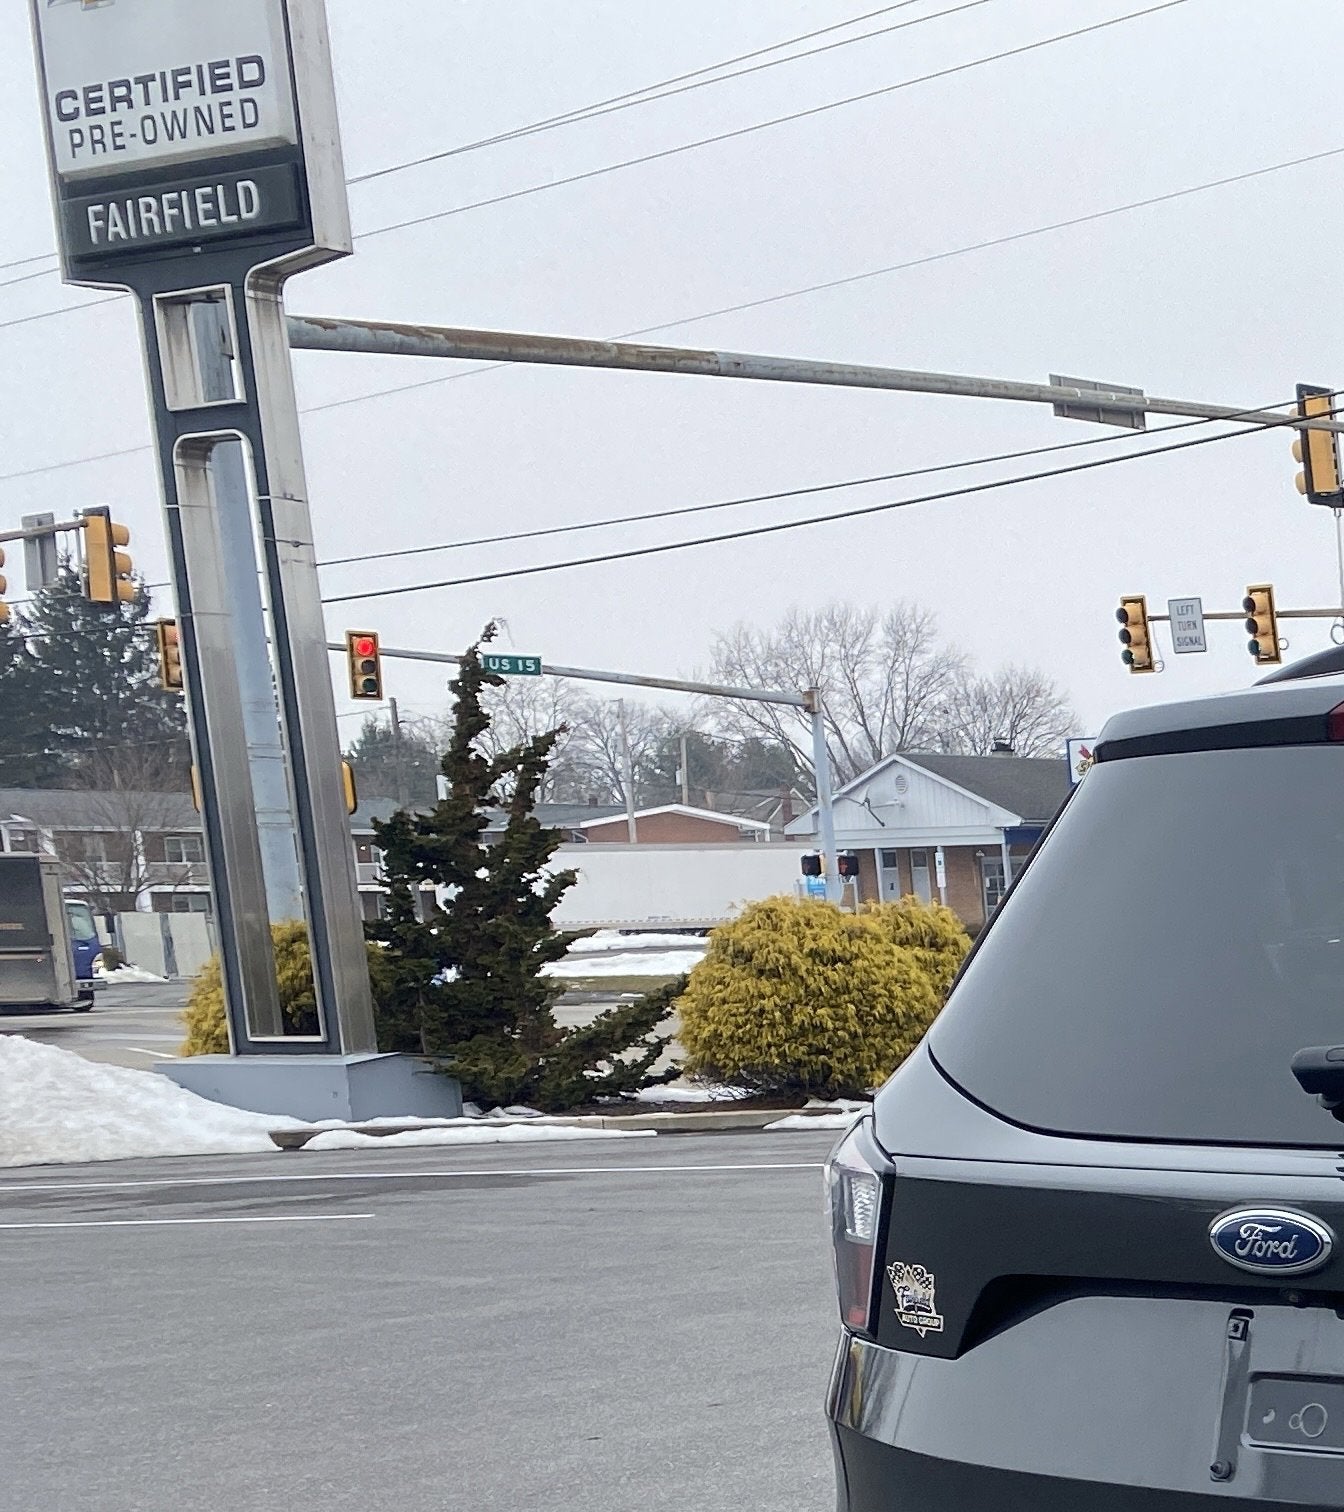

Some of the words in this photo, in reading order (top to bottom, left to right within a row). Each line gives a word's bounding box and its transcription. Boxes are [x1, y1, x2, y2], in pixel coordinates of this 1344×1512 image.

[55, 54, 266, 122] CERTIFIED
[69, 97, 260, 159] PRE-OWNED
[87, 179, 261, 245] FAIRFIELD
[1176, 604, 1194, 616] LEFT
[1177, 620, 1198, 631] TURN
[1176, 636, 1204, 647] SIGNAL
[488, 657, 511, 671] US
[517, 659, 536, 672] 15
[1234, 1222, 1299, 1259] Ford
